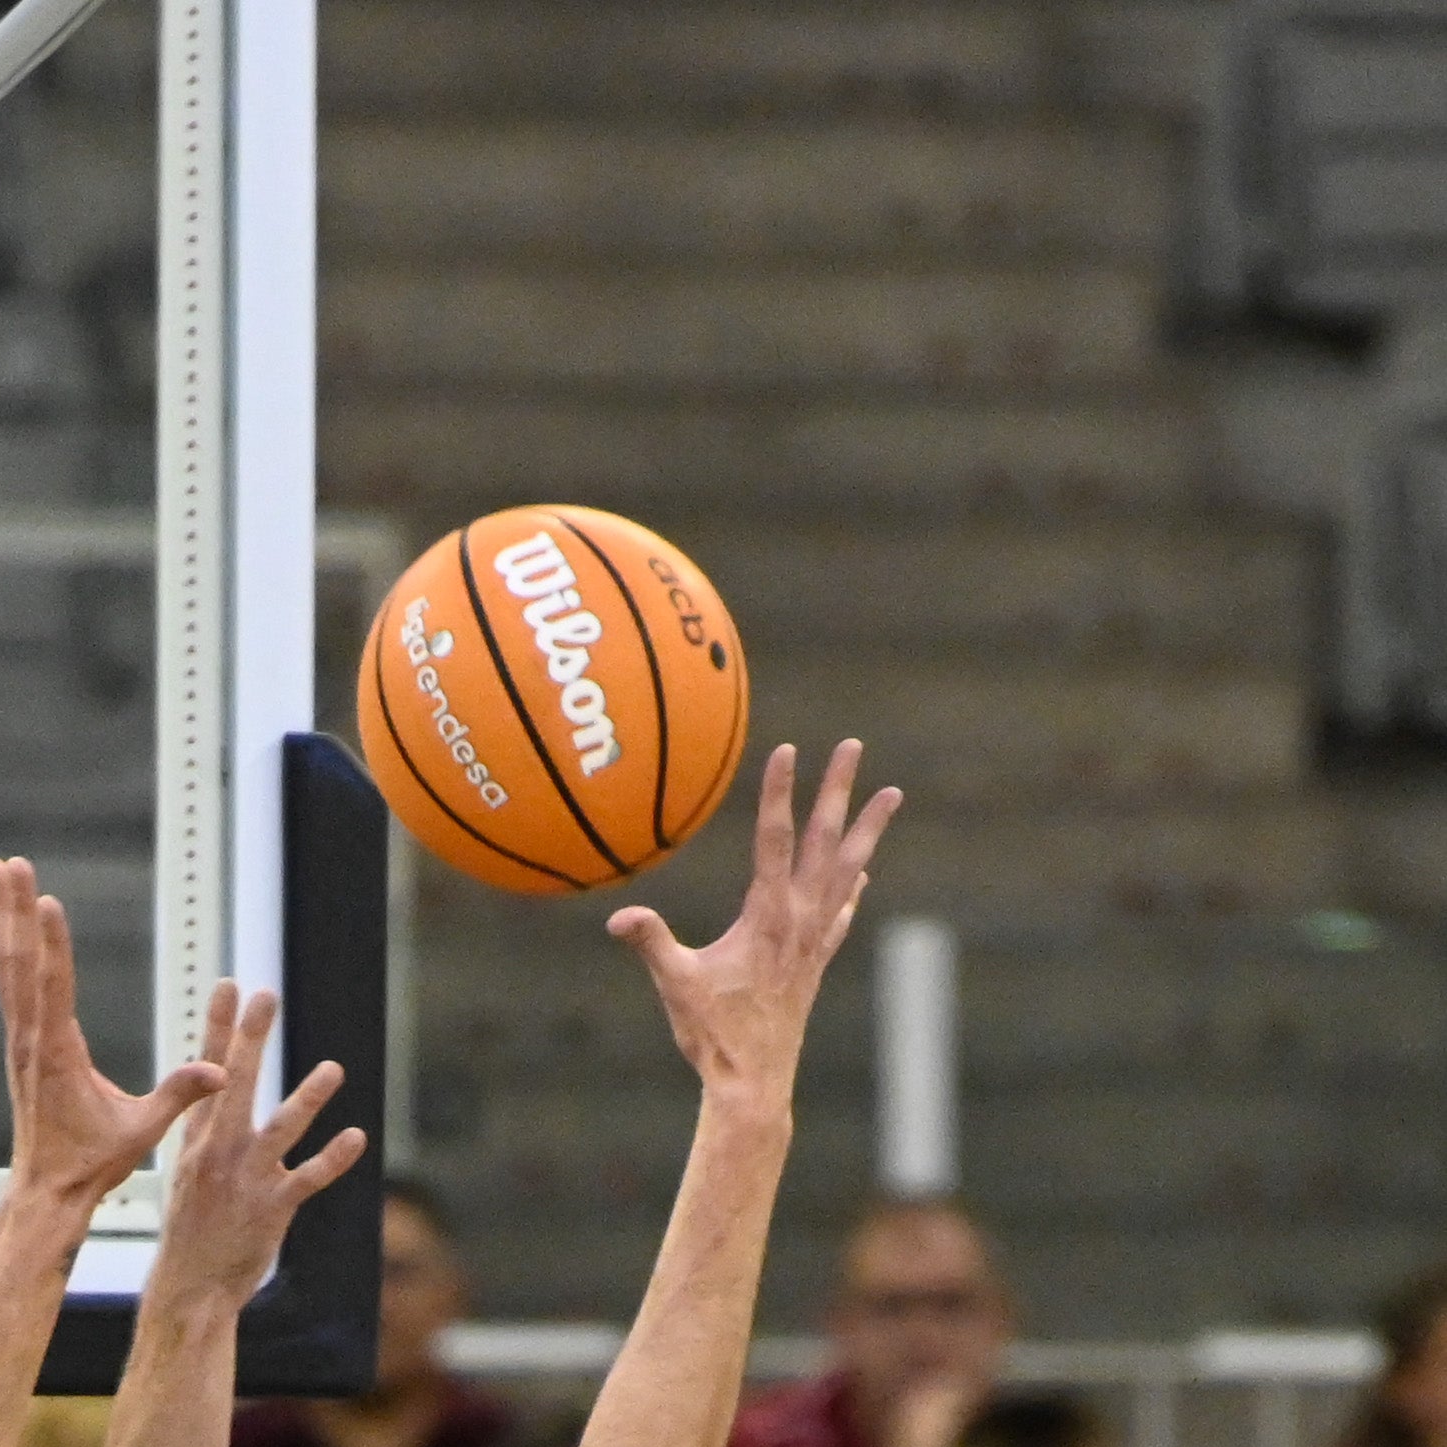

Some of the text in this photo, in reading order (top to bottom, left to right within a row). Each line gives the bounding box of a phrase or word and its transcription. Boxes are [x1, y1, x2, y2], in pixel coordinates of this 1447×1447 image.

[493, 531, 622, 778] Wilson
[648, 557, 705, 646] acb
[416, 665, 510, 809] endesa
